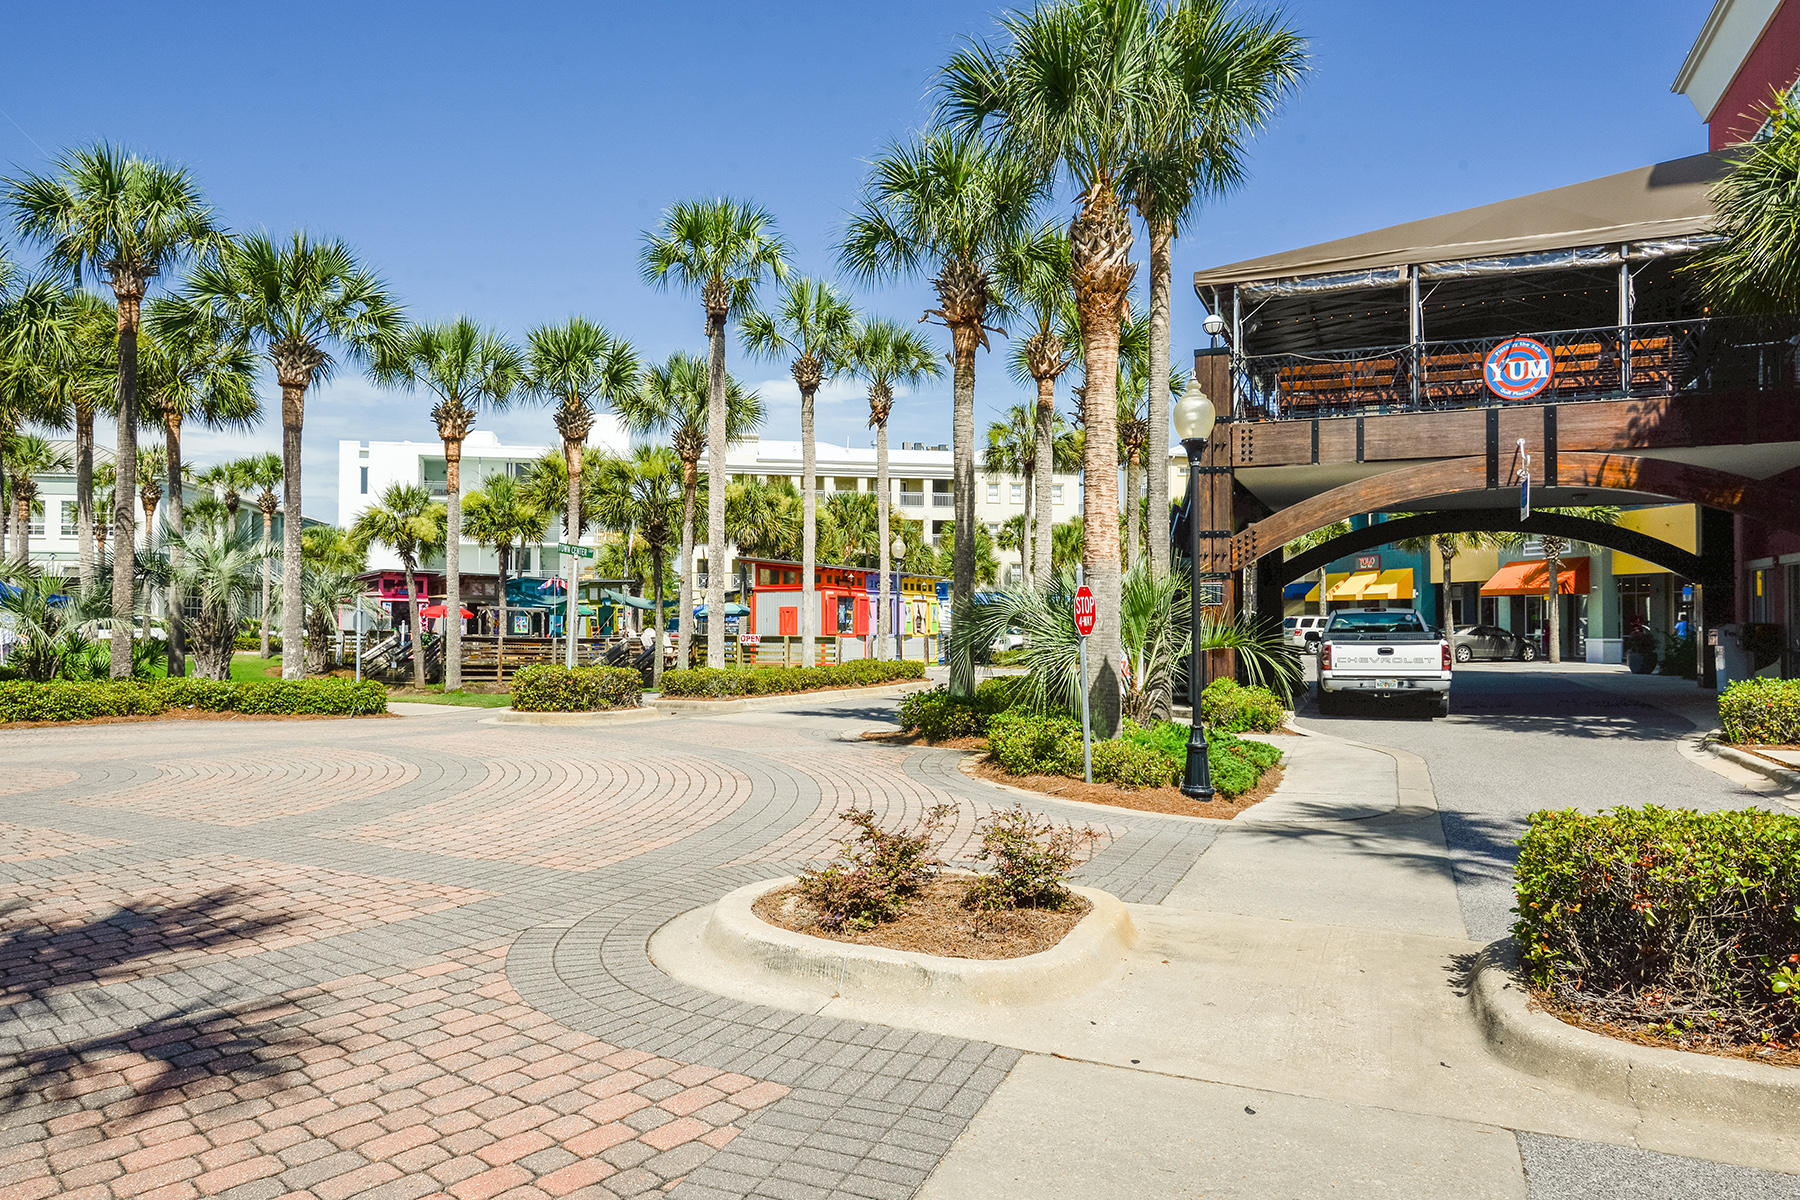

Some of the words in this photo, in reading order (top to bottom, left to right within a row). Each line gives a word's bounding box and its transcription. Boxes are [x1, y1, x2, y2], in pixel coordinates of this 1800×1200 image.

[1488, 358, 1549, 381] YUM
[559, 543, 571, 553] TOWN
[571, 546, 588, 556] CENTER
[1358, 556, 1376, 566] YOLO
[1075, 596, 1095, 615] STOP
[740, 634, 761, 643] OPEN
[1337, 656, 1435, 664] CHEVROLET
